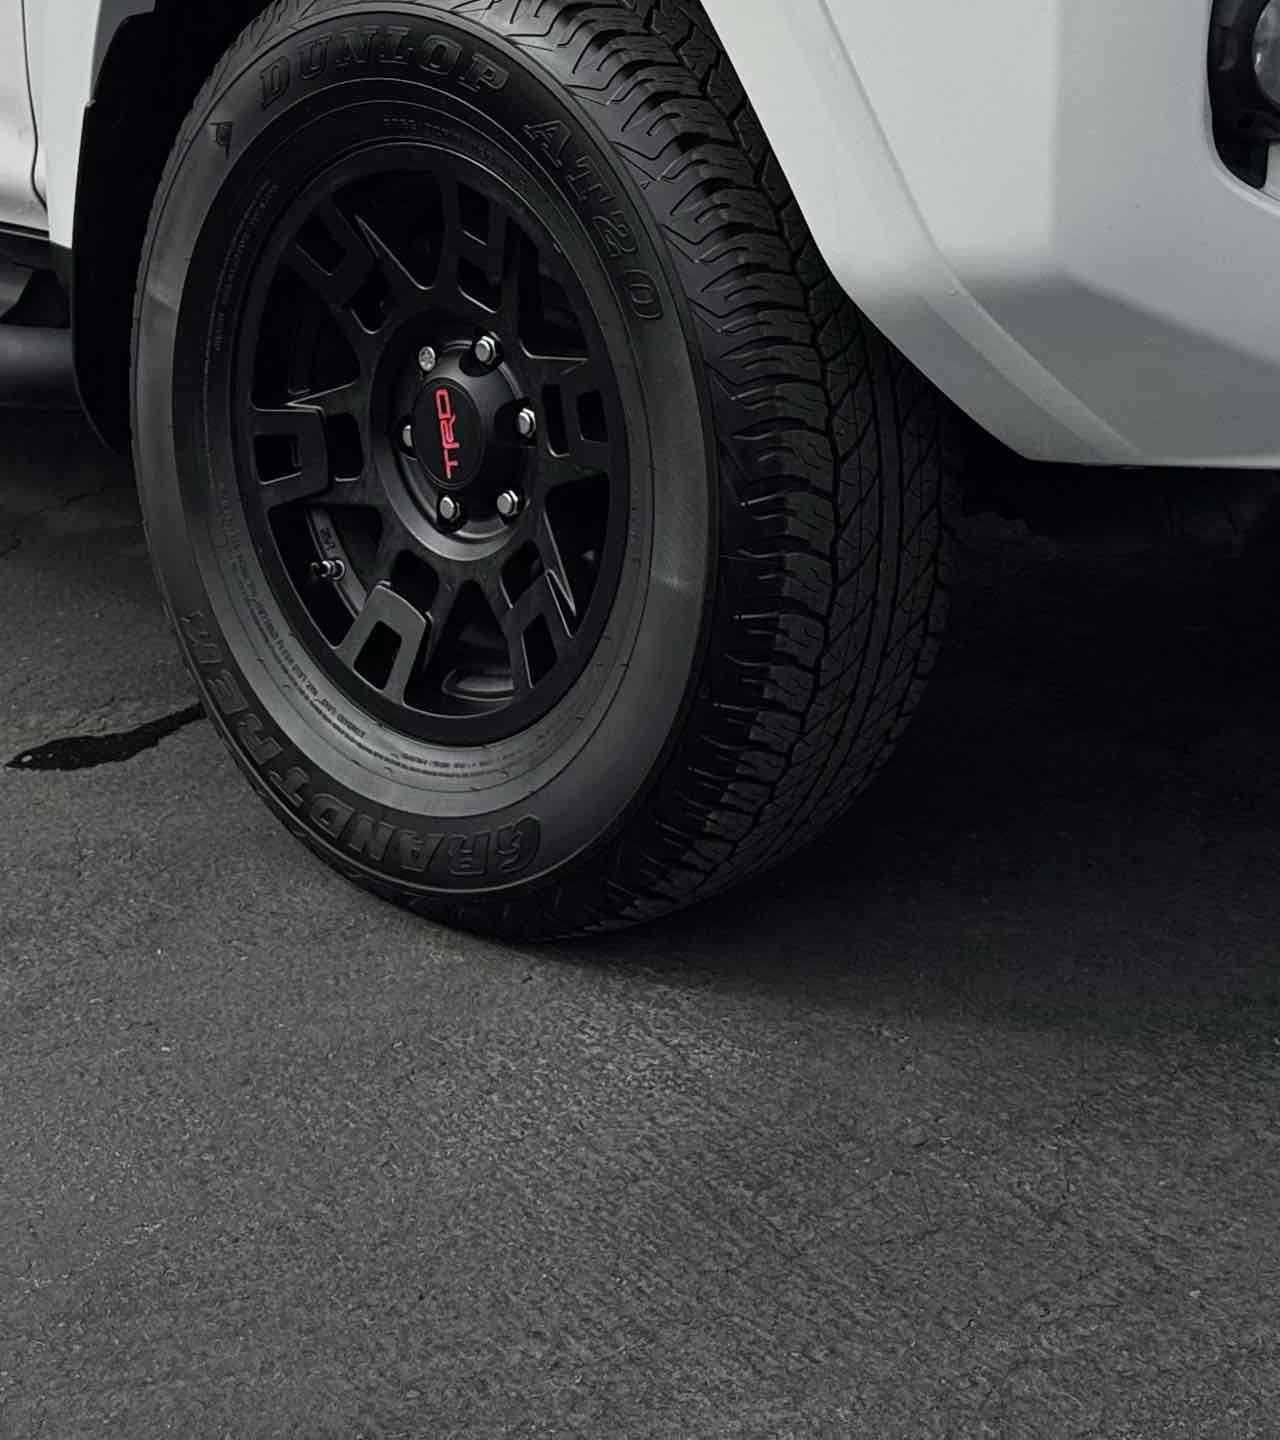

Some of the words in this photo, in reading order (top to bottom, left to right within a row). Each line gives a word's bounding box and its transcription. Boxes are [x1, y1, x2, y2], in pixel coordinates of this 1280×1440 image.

[260, 24, 510, 110] DUNLOP
[522, 119, 663, 321] AT20
[435, 388, 460, 480] TRD
